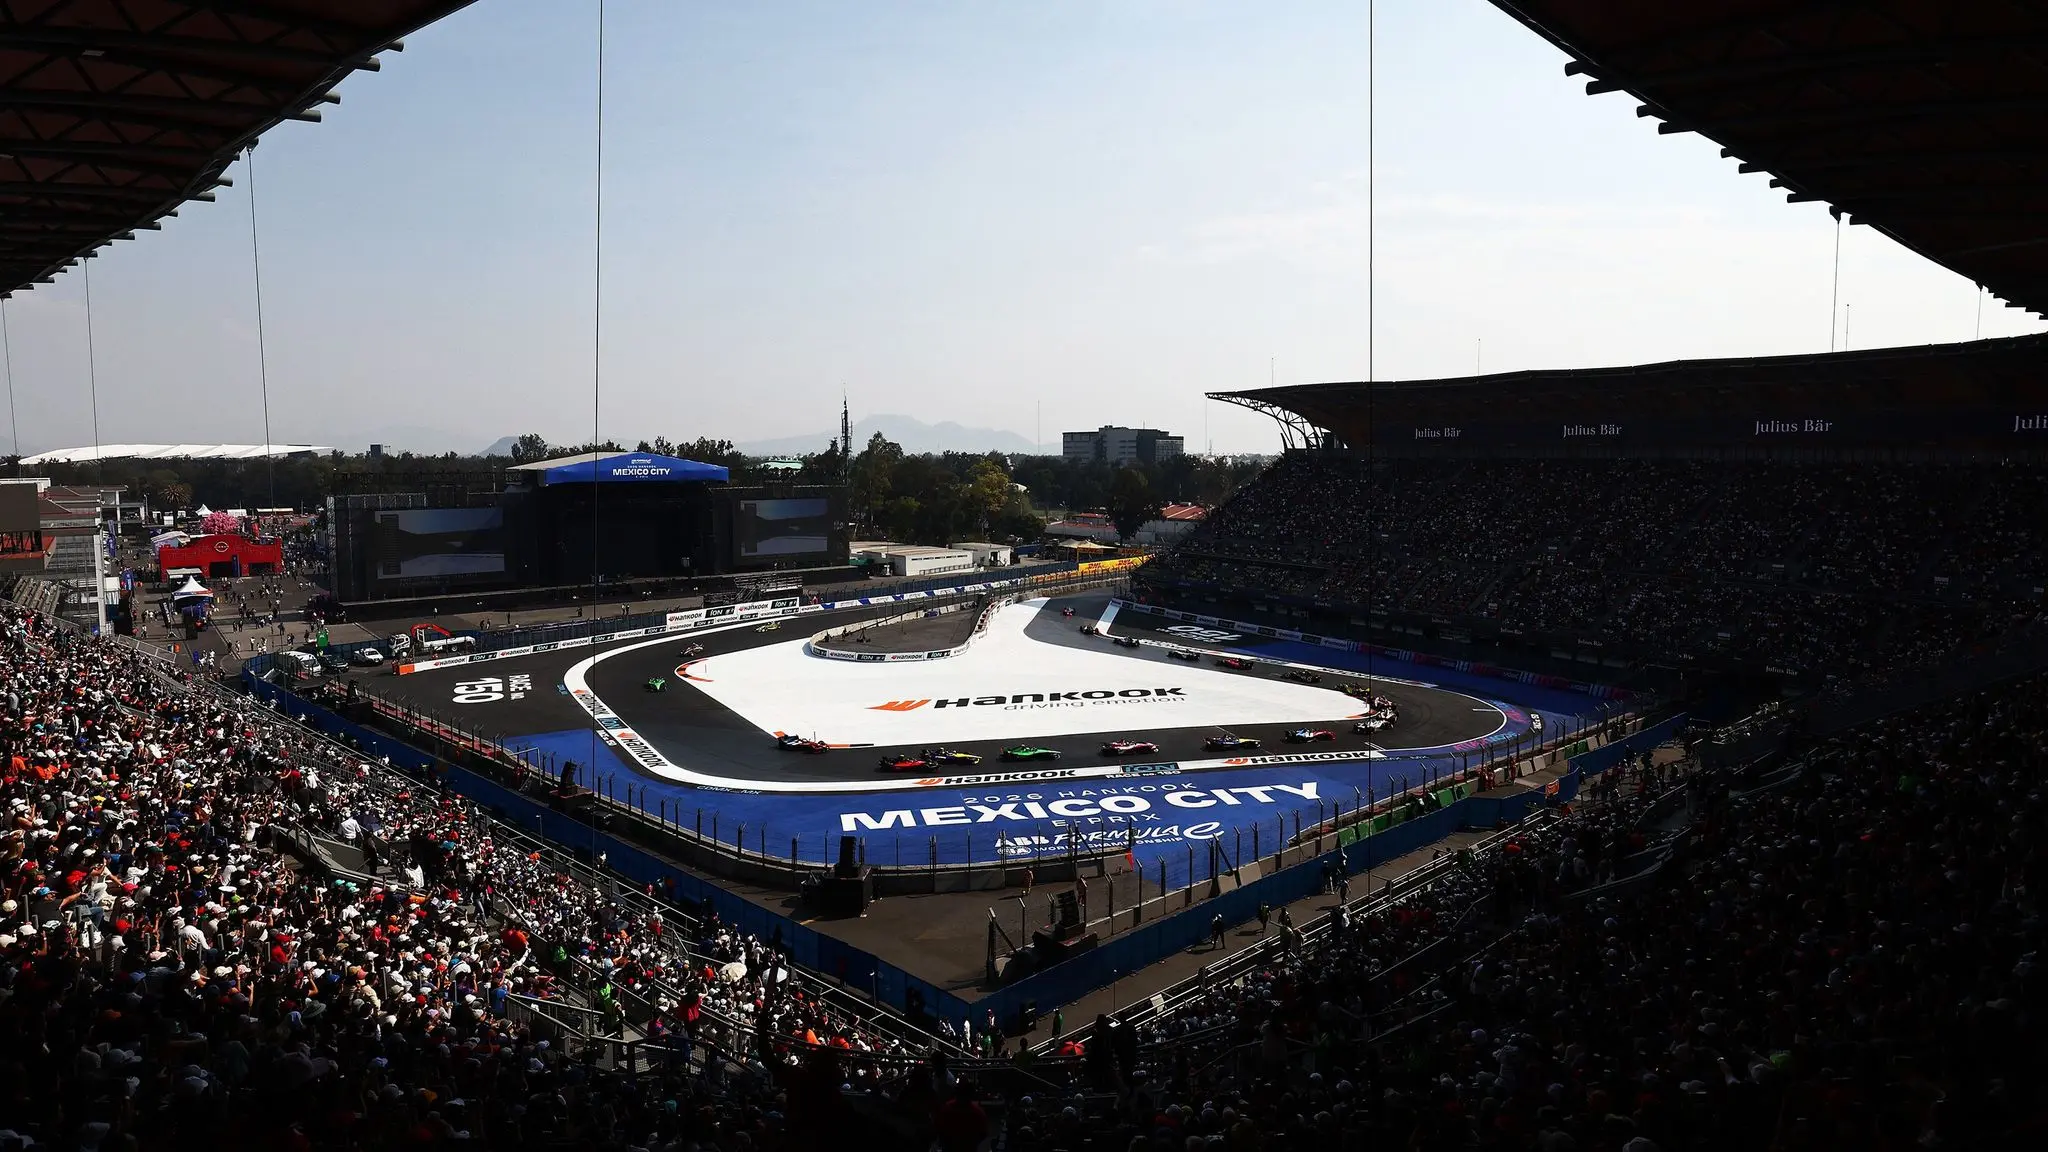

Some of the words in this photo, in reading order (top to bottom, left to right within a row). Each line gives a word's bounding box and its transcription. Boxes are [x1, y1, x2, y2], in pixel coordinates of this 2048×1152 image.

[1415, 427, 1441, 440] Julius
[1444, 427, 1462, 438] Bär
[1562, 424, 1596, 439] Julius
[1600, 424, 1623, 436] Bär
[1755, 420, 1798, 436] Julius
[1803, 419, 1833, 432] Bär
[612, 468, 649, 476] MEXICO
[650, 468, 671, 476] CITY
[452, 677, 505, 704] 150
[1003, 701, 1085, 712] driving
[1092, 694, 1186, 706] emotion
[963, 793, 1043, 806] 2026
[1058, 782, 1198, 798] HANKOOK
[840, 795, 1152, 832] MEXICO
[1164, 782, 1322, 809] CITY
[995, 835, 1050, 848] ABB
[1053, 825, 1179, 846] FORMULA
[1086, 837, 1183, 849] CHAMPONSHIP
